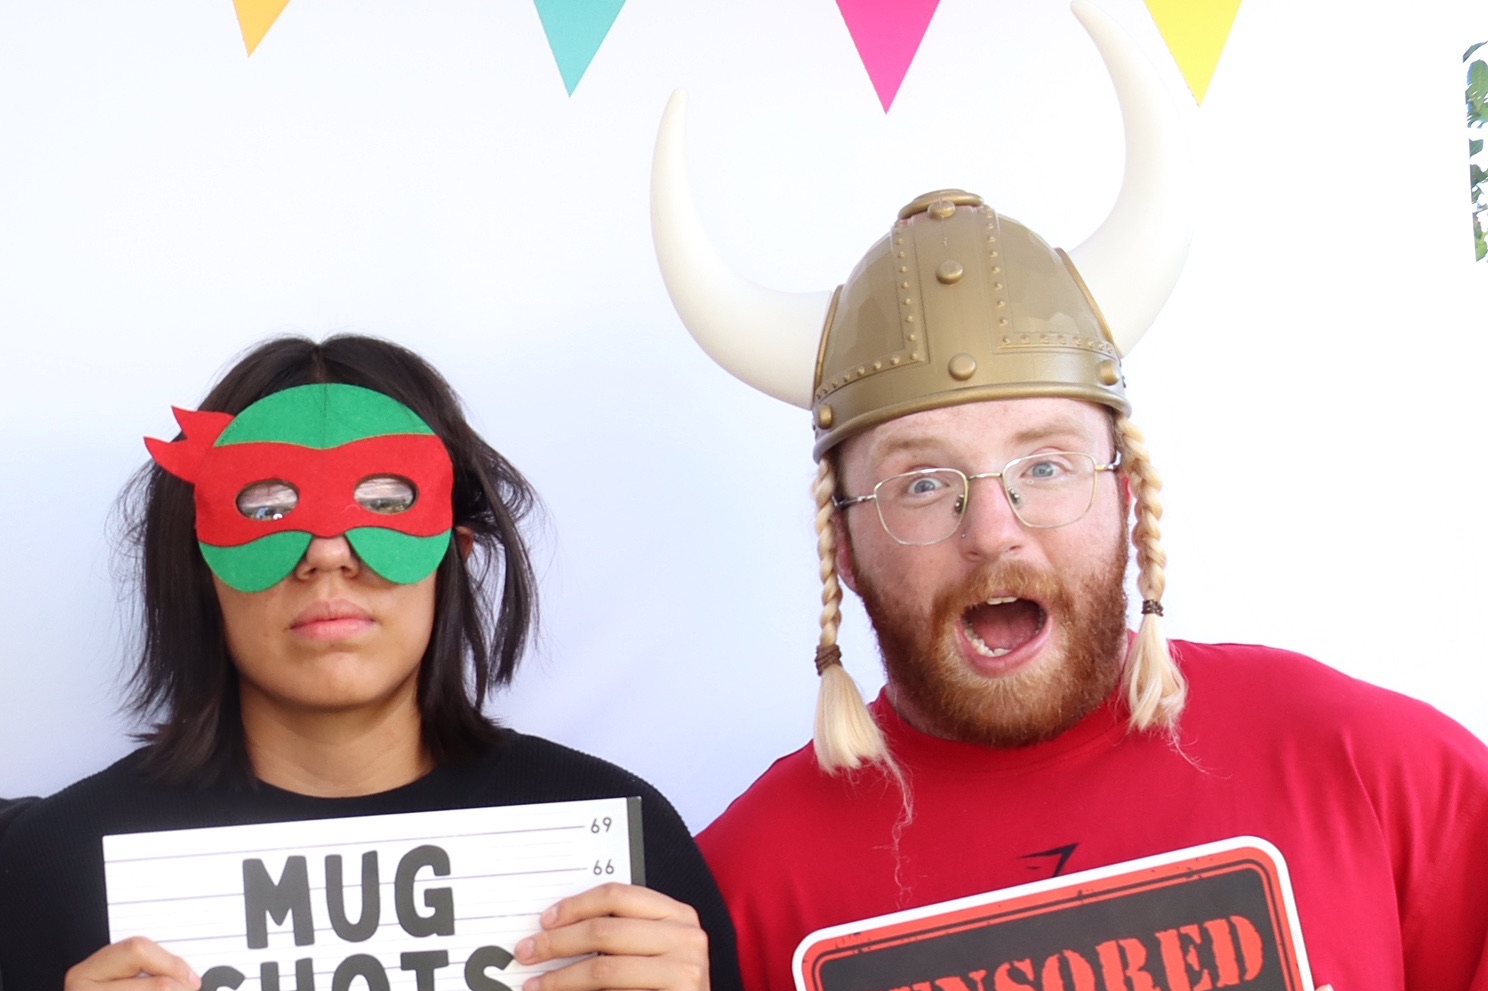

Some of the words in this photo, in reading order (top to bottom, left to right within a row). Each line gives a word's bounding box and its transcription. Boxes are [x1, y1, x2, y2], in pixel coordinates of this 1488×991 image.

[590, 817, 613, 835] 69
[592, 859, 615, 876] 66
[241, 844, 456, 950] MUG
